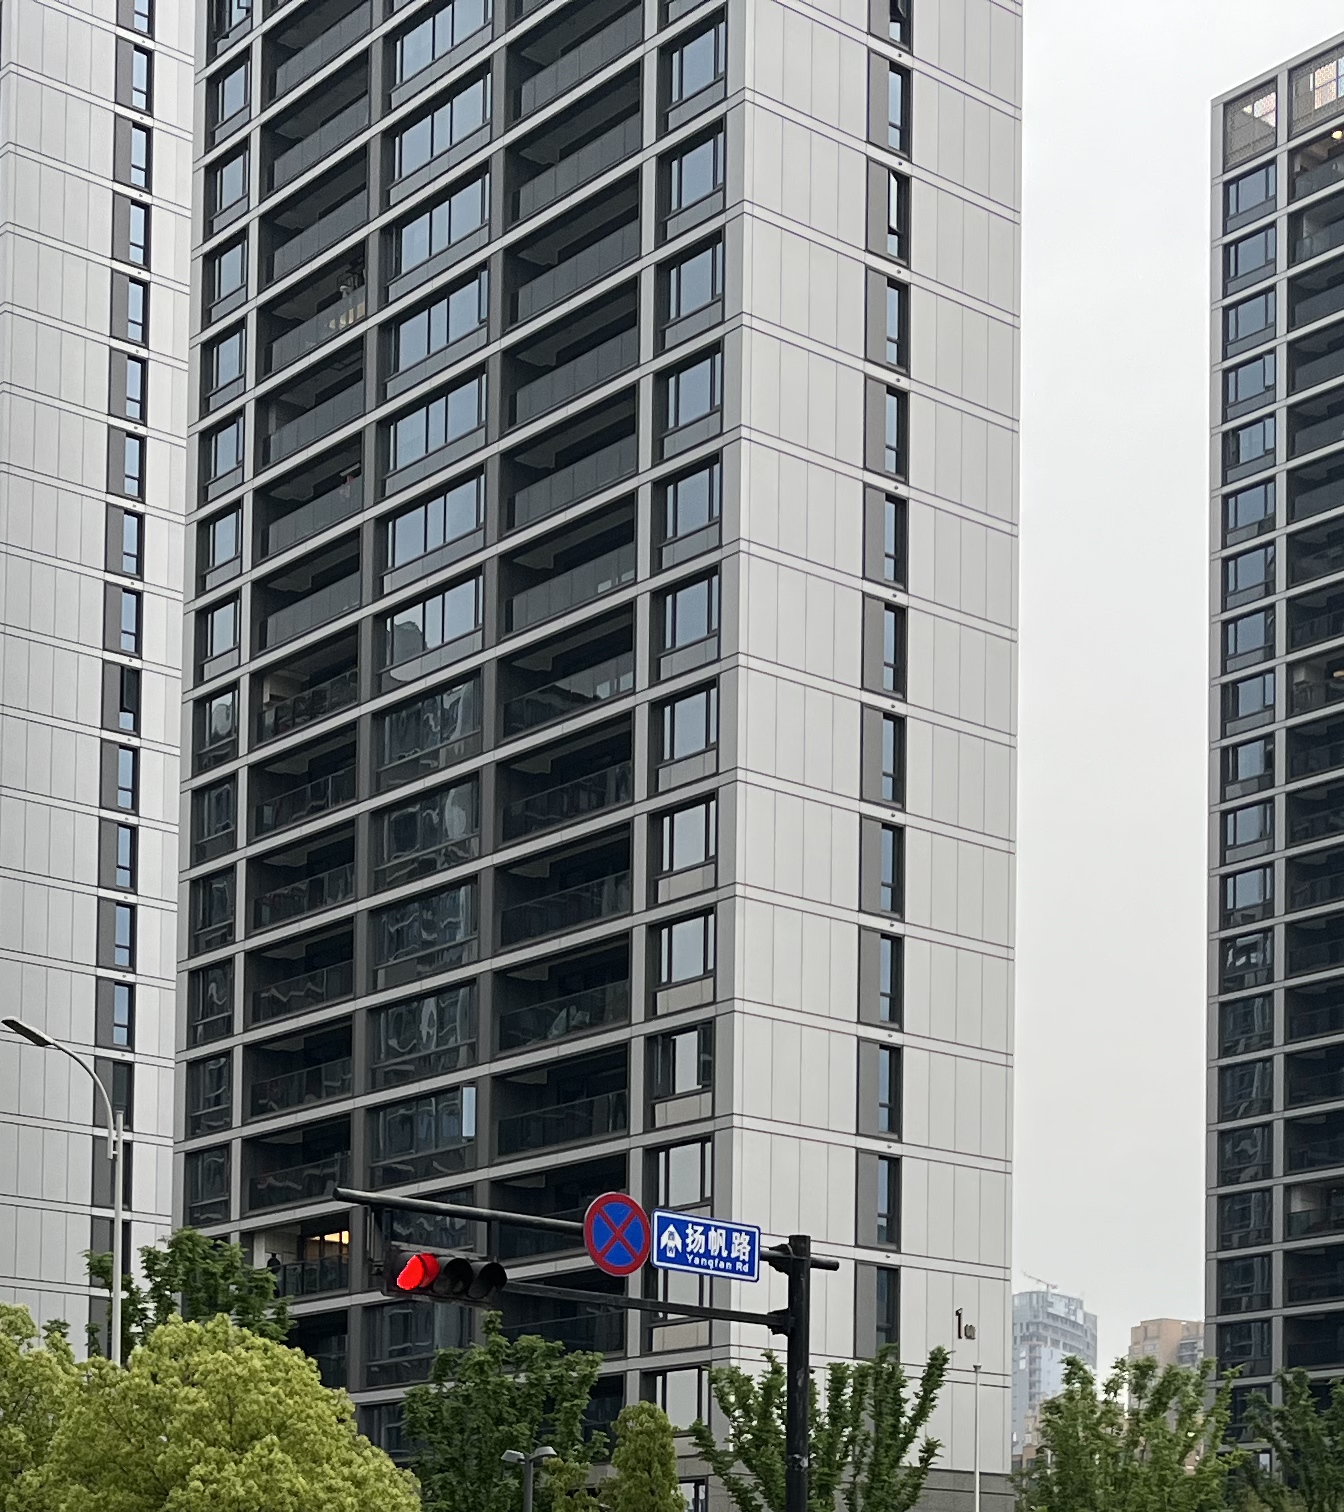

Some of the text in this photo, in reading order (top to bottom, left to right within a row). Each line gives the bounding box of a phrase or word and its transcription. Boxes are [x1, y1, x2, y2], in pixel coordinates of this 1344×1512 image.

[686, 1223, 751, 1262] 扬帆路
[686, 1253, 749, 1272] Yangfan Rd
